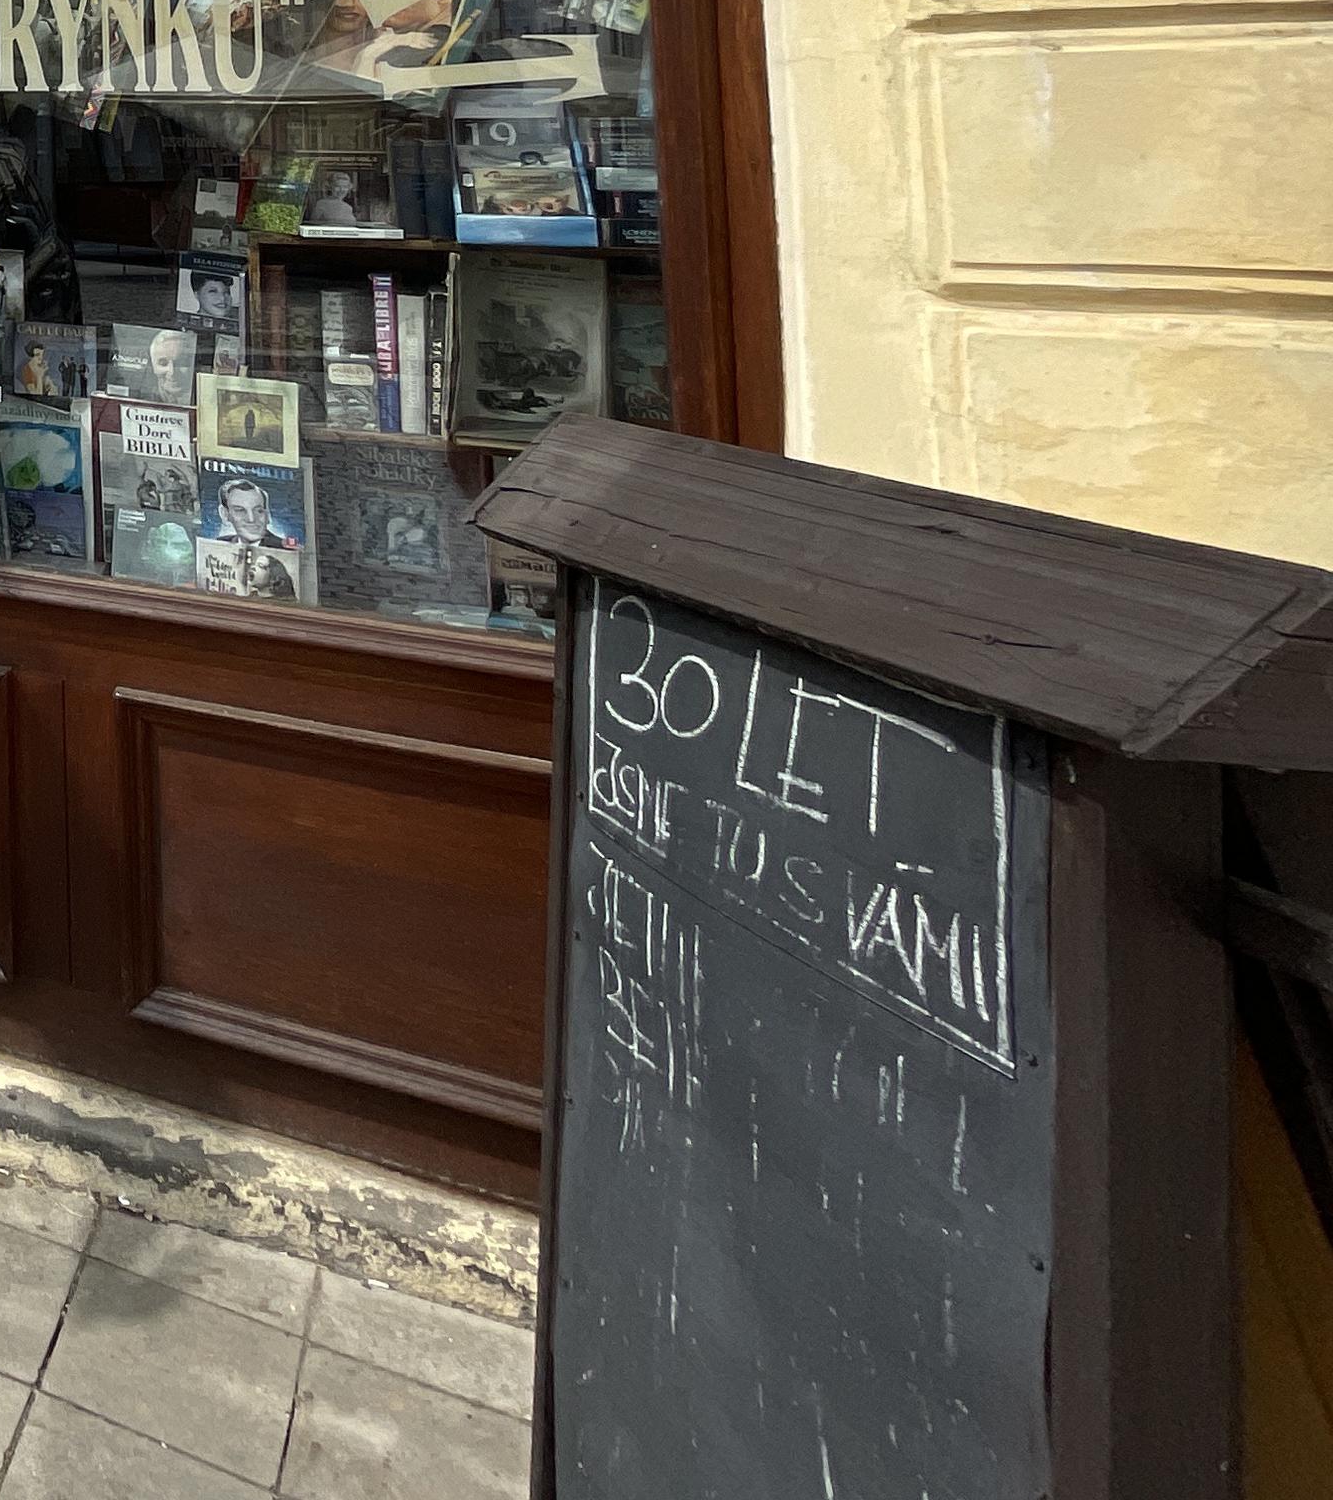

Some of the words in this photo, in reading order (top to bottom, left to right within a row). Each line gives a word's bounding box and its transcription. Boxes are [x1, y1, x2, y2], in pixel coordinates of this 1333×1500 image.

[125, 406, 184, 428] Gustave
[127, 438, 188, 460] BIBLIA
[606, 594, 721, 739] 30
[735, 648, 957, 837] LET
